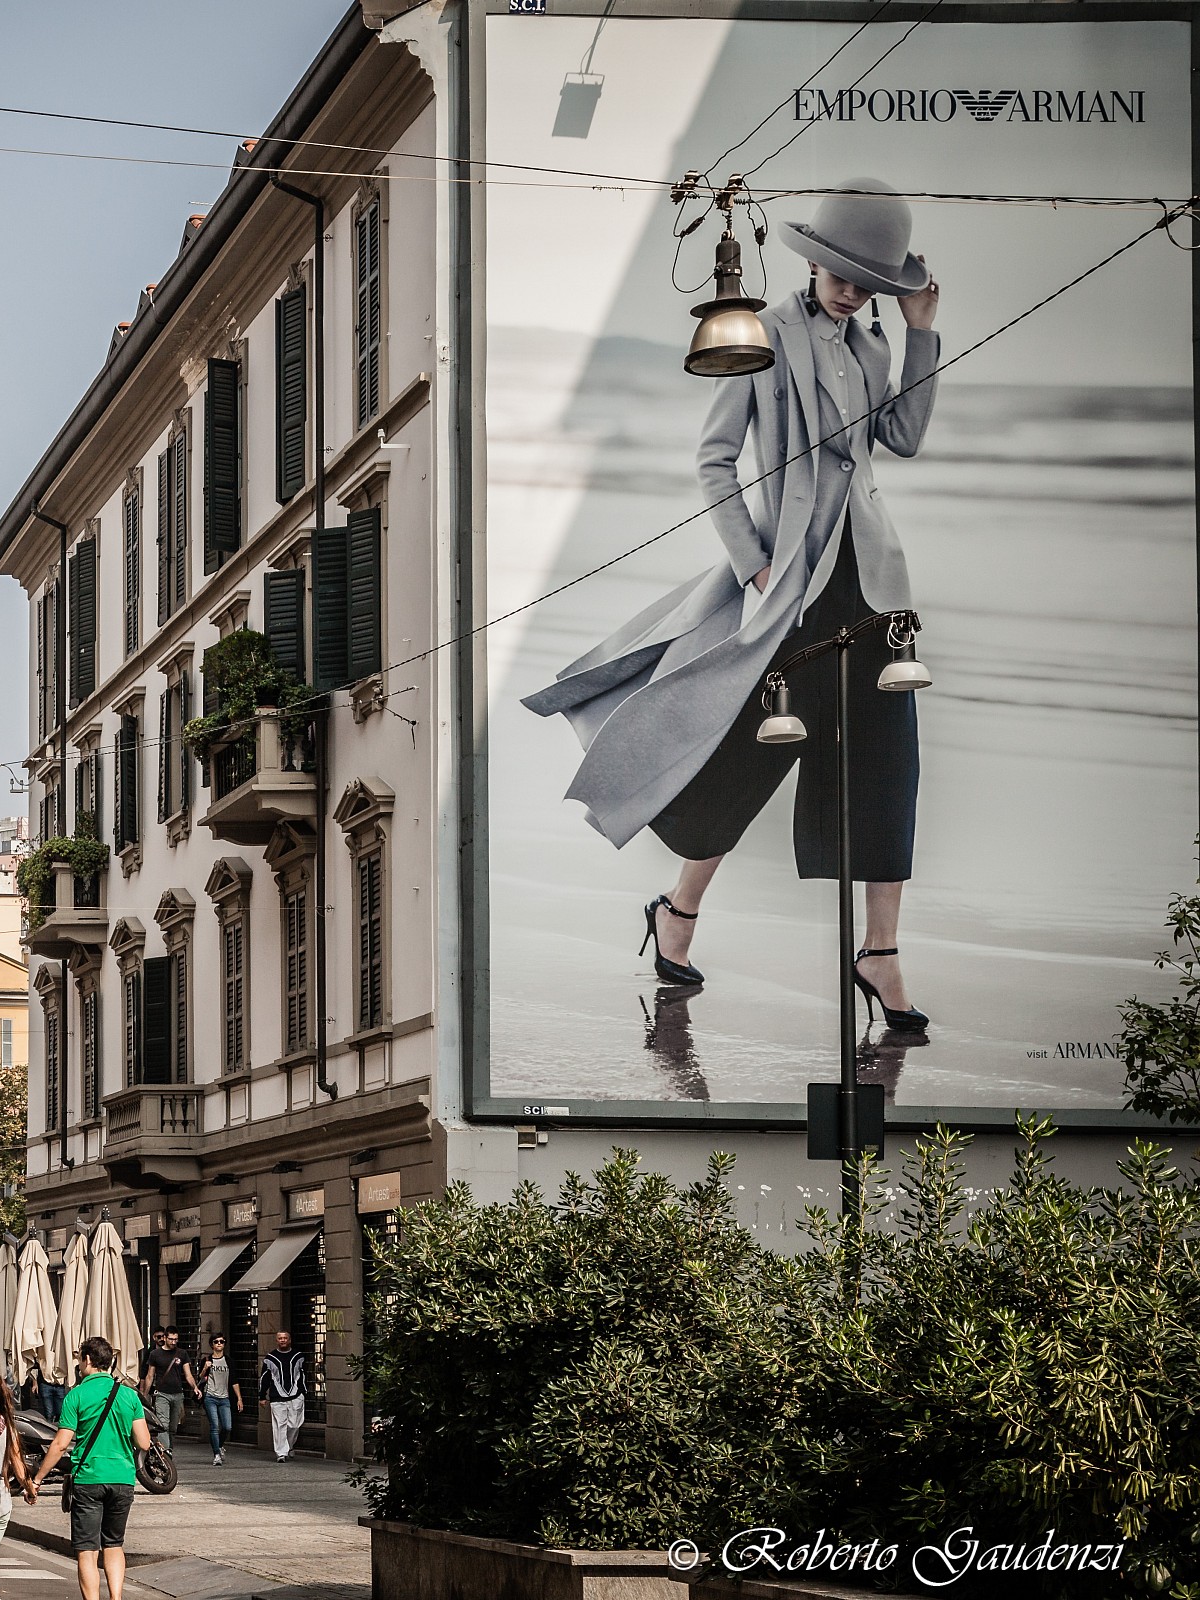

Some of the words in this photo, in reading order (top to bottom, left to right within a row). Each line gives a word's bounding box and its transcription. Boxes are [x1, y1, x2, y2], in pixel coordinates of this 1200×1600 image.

[793, 88, 958, 123] EMPORIO
[1006, 89, 1146, 123] ARMANI
[1026, 1049, 1048, 1059] visit
